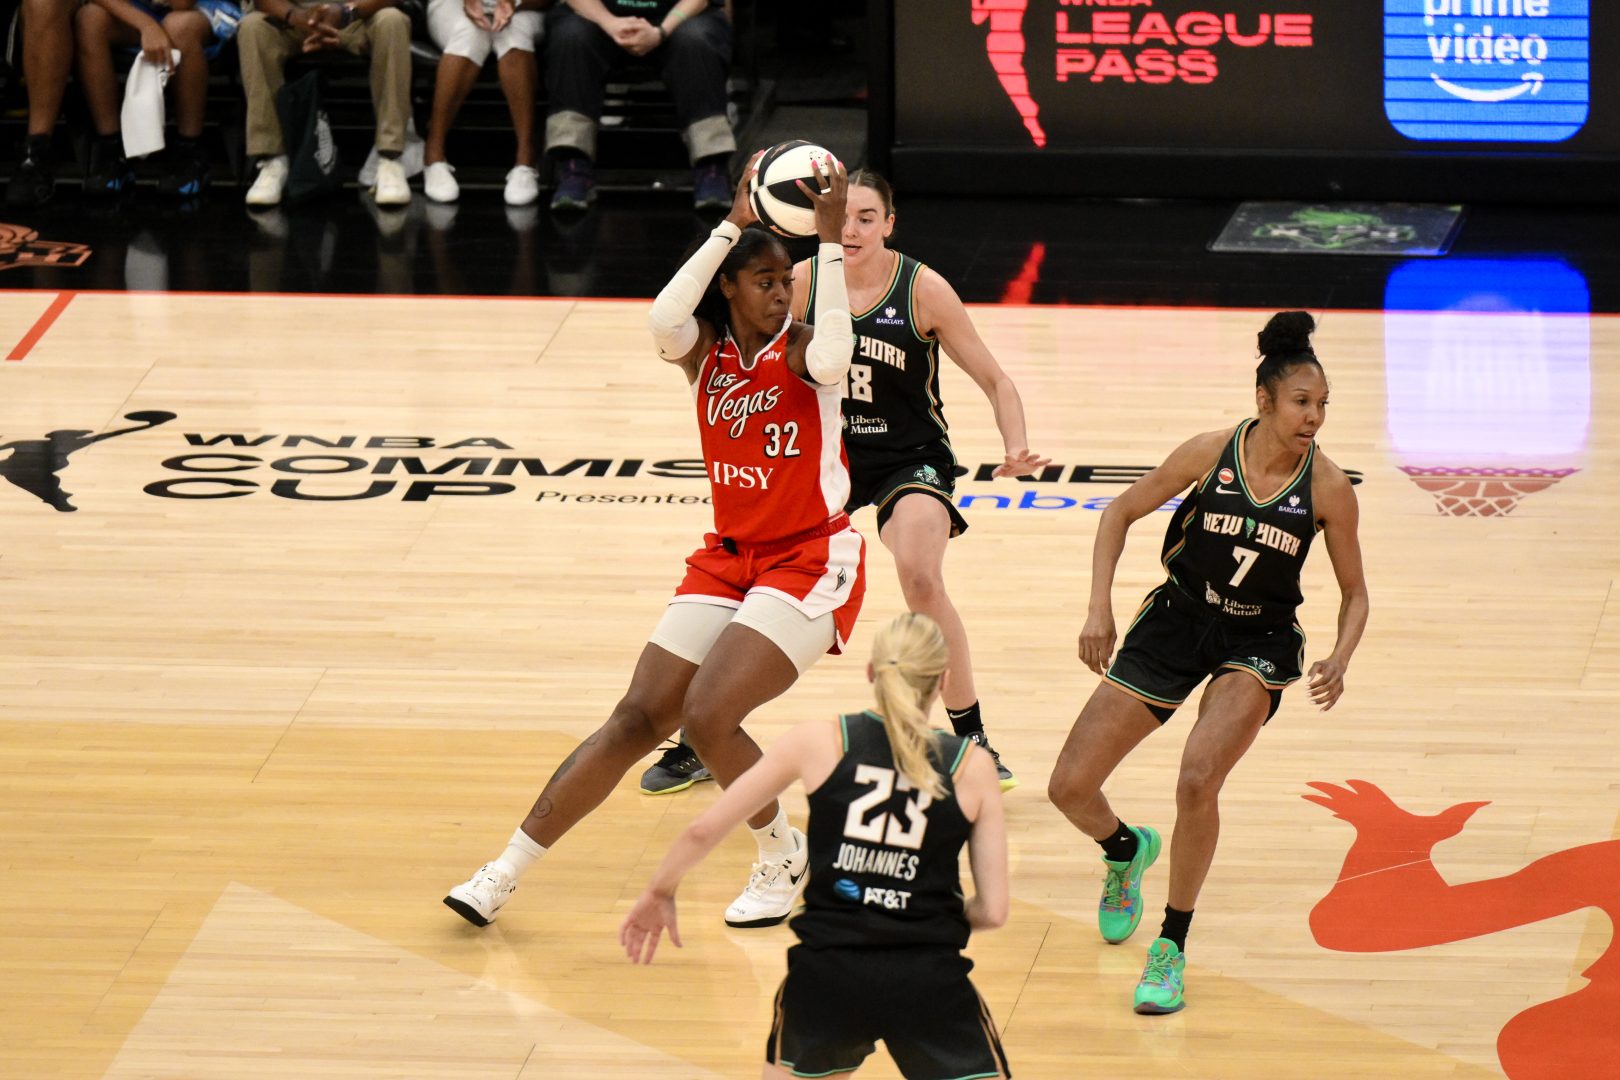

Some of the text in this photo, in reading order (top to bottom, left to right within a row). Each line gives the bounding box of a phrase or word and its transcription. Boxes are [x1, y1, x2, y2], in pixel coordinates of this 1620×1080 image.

[1056, 12, 1313, 46] LEAGUE
[1427, 23, 1548, 65] video
[1056, 49, 1219, 84] PASS
[762, 350, 782, 362] ally
[859, 335, 906, 371] YORK
[706, 366, 738, 394] Las
[706, 379, 783, 438] Vegas
[850, 415, 887, 426] Liberty
[183, 433, 514, 449] WNBA
[764, 421, 801, 457] 32
[850, 424, 888, 435] Mutual
[143, 477, 516, 501] CUP
[713, 461, 774, 490] IPSY
[1278, 505, 1307, 515] BARCLAYS
[1203, 512, 1301, 557] NEW YORK
[1228, 545, 1260, 588] 7
[1222, 605, 1261, 616] Mutual
[1224, 598, 1262, 610] Liberty
[843, 764, 932, 850] 23
[863, 886, 911, 910] AT&T
